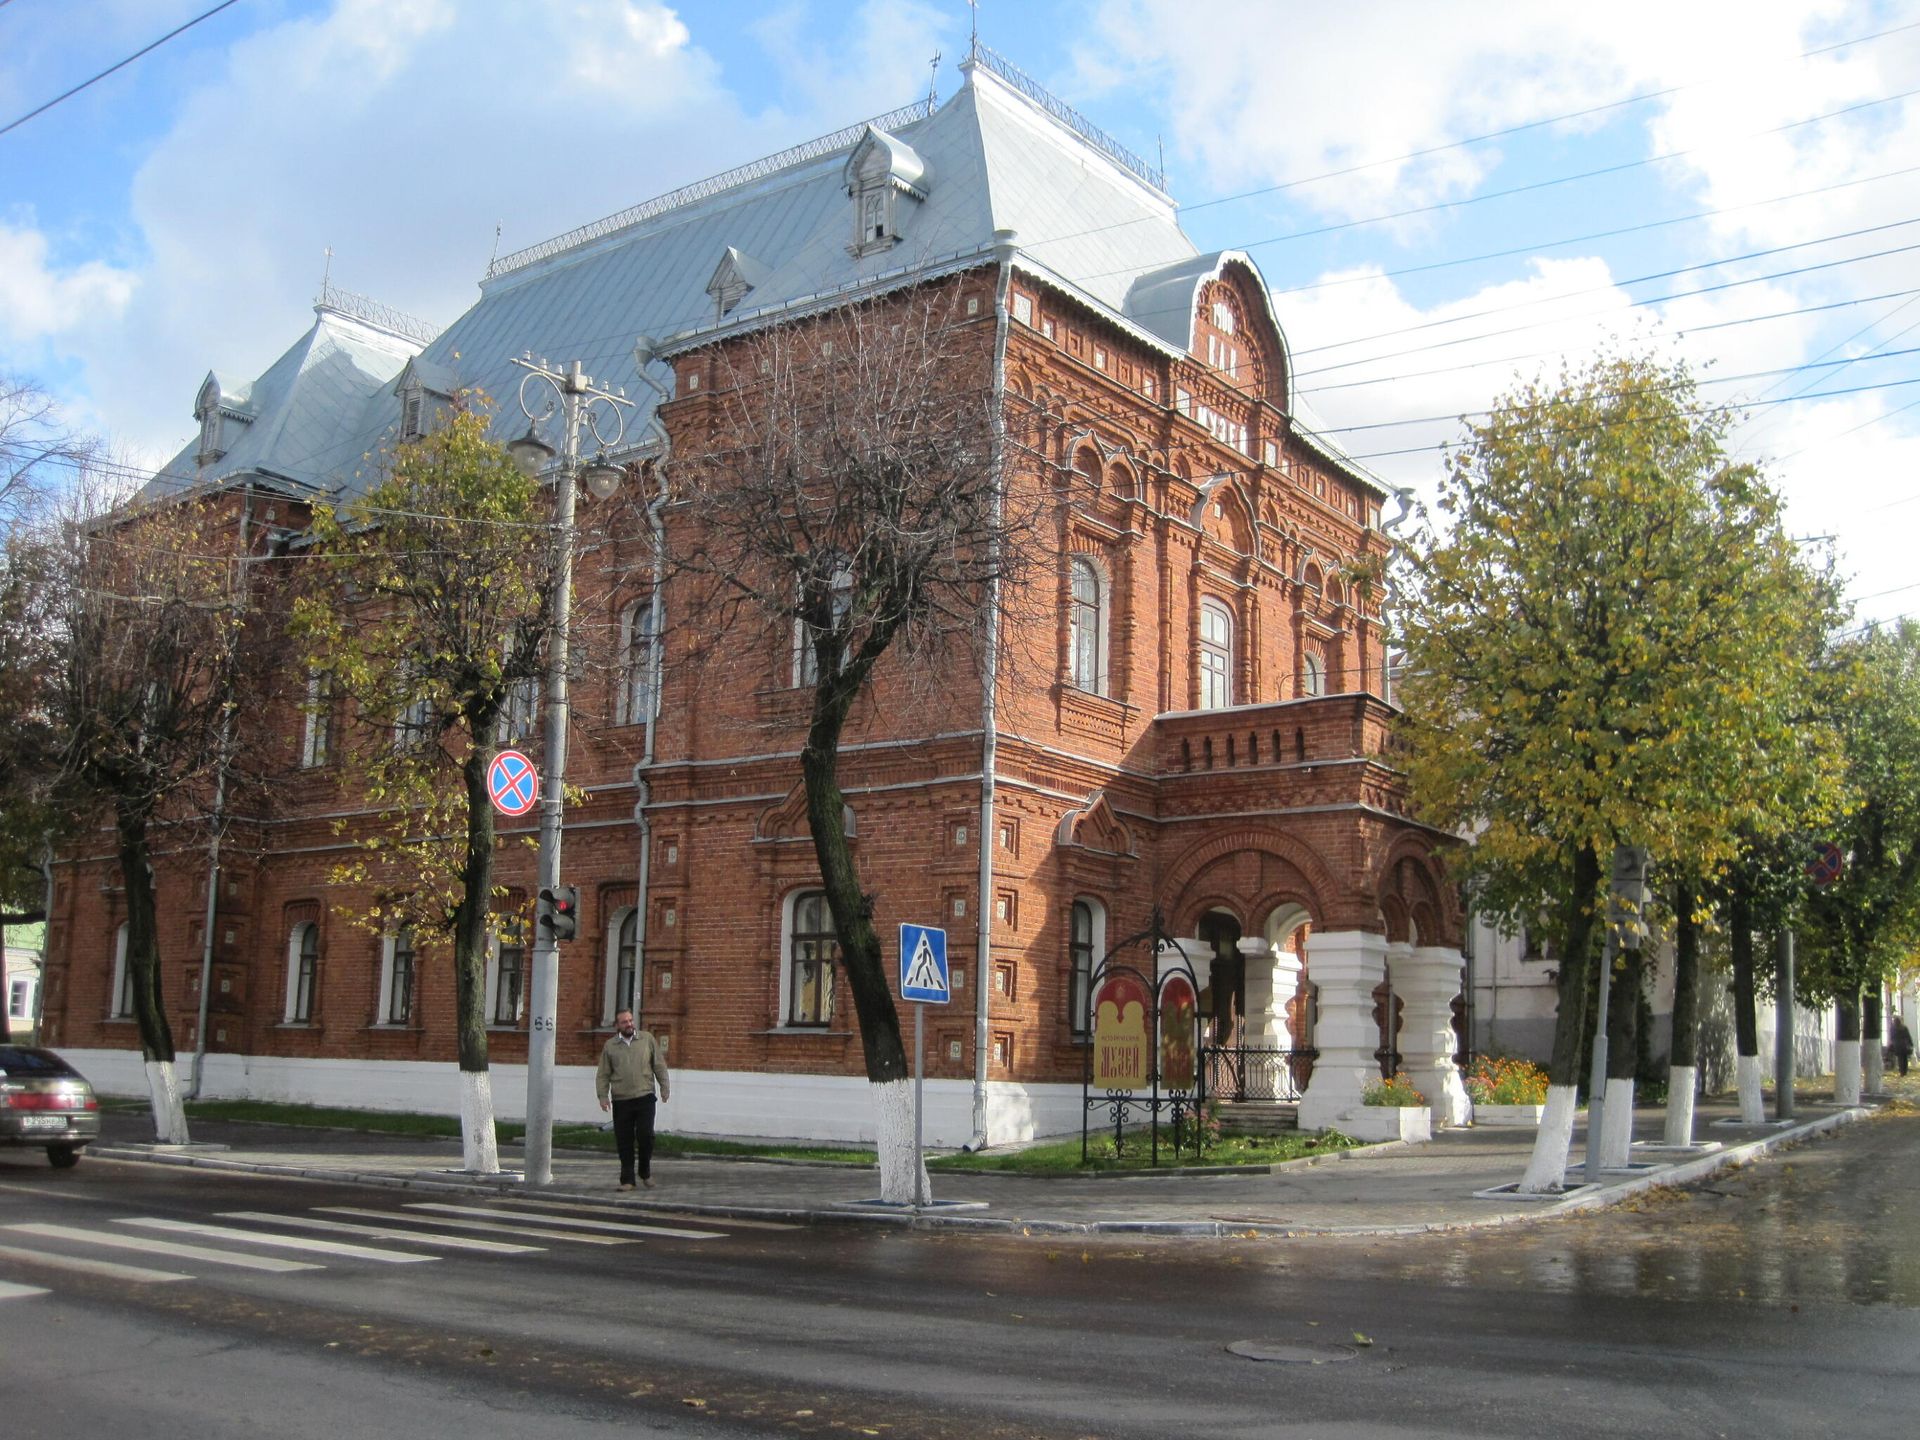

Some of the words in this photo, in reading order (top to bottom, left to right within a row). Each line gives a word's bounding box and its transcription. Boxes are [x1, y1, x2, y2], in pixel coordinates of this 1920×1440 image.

[1212, 302, 1234, 336] 1900
[1197, 405, 1247, 456] МУЗЕЙ
[1101, 1044, 1139, 1078] МУЗЕЙ
